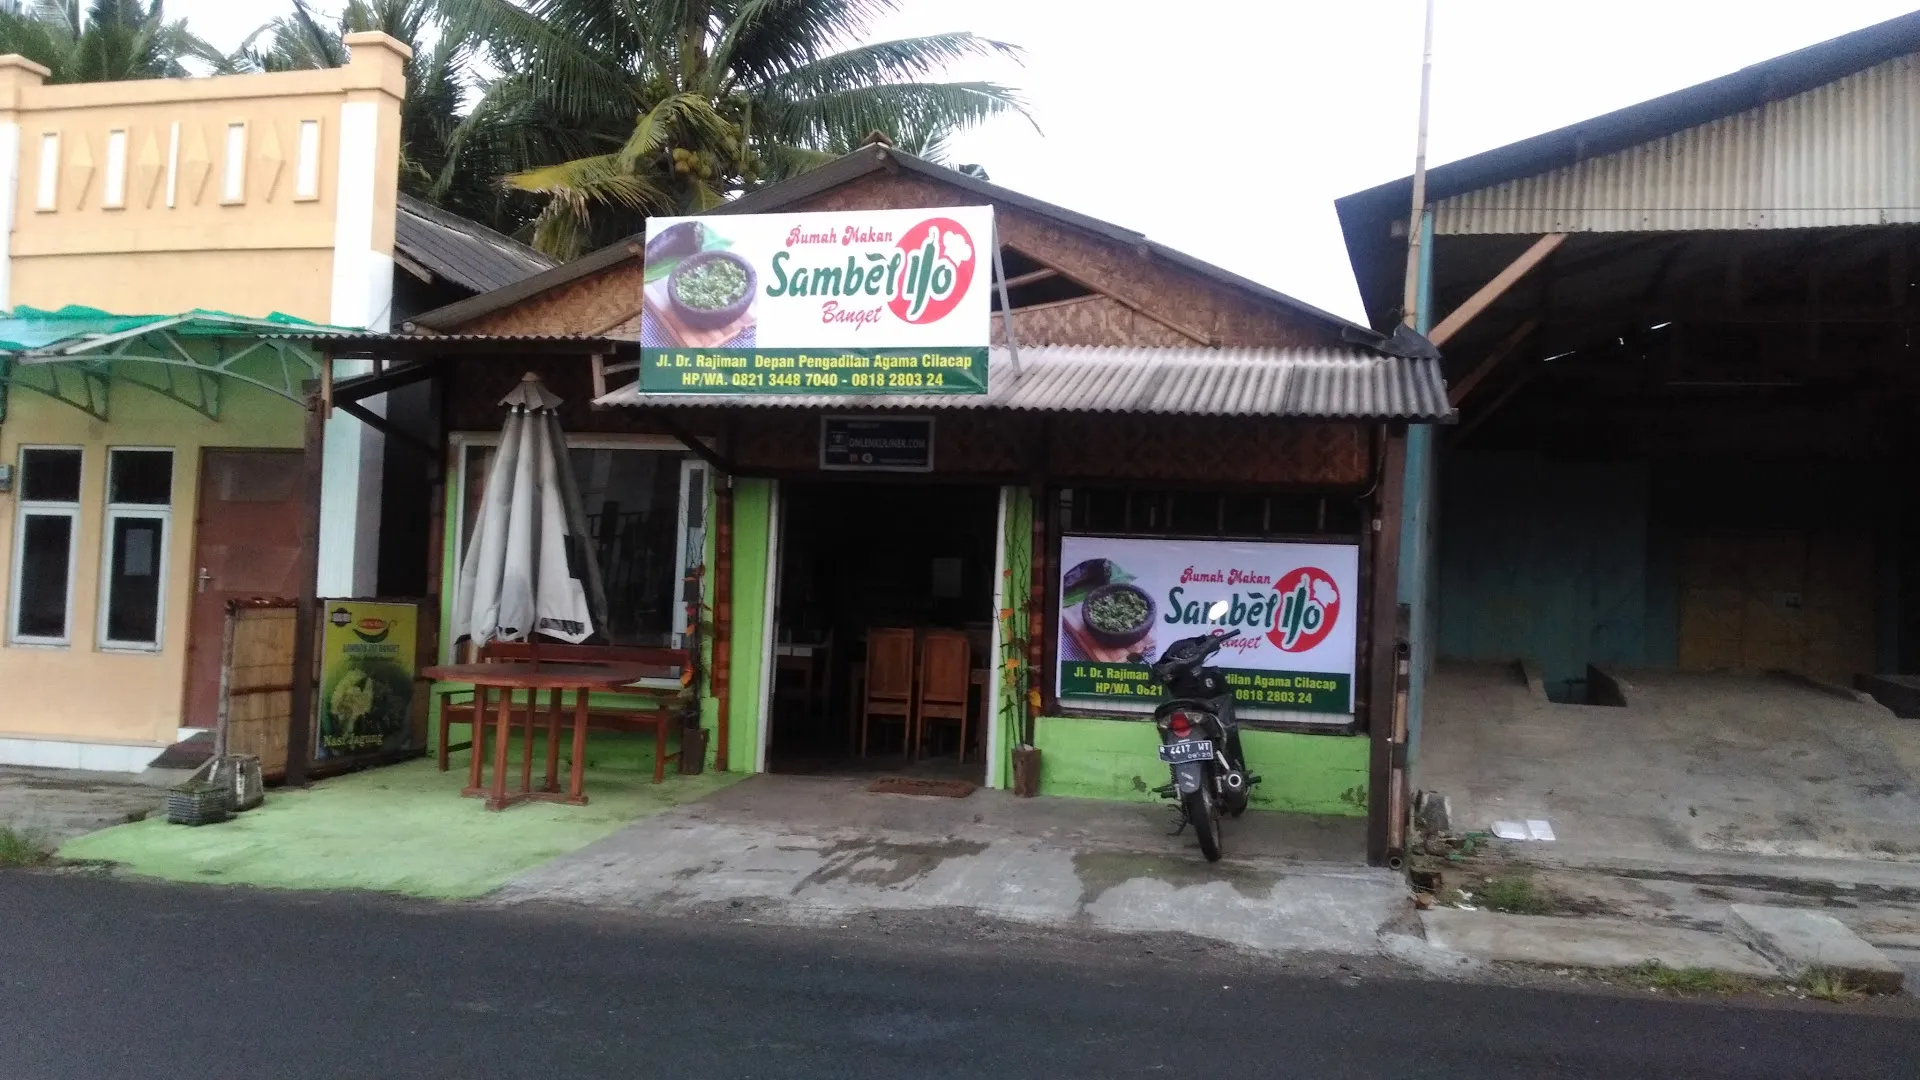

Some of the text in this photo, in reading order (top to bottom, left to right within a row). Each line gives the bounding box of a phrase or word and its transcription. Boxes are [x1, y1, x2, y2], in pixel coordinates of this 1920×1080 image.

[786, 225, 892, 247] Rumah Makan
[822, 301, 883, 330] Banget
[656, 354, 972, 371] Jl. Dr. Rajiman Depan Pengadilan Agama Cilacap
[682, 373, 728, 387] HP/WA.
[732, 373, 764, 387] 0821
[768, 373, 801, 387] 3448
[805, 373, 838, 387] 7040
[851, 373, 885, 387] 0818
[888, 373, 922, 387] 2803
[926, 373, 944, 387] 24
[1180, 565, 1271, 585] Rumah Makan
[1074, 666, 1087, 678] Jl.
[1090, 667, 1104, 678] Dr.
[1106, 668, 1149, 682] Rajiman
[1254, 675, 1292, 690] Agama
[1294, 676, 1336, 692] Cilacap
[1095, 682, 1133, 695] HP/WA.
[1236, 689, 1264, 702] 0818
[1266, 690, 1295, 703] 2803
[1298, 691, 1312, 704] 24
[1159, 746, 1166, 754] R
[1197, 743, 1209, 751] WT
